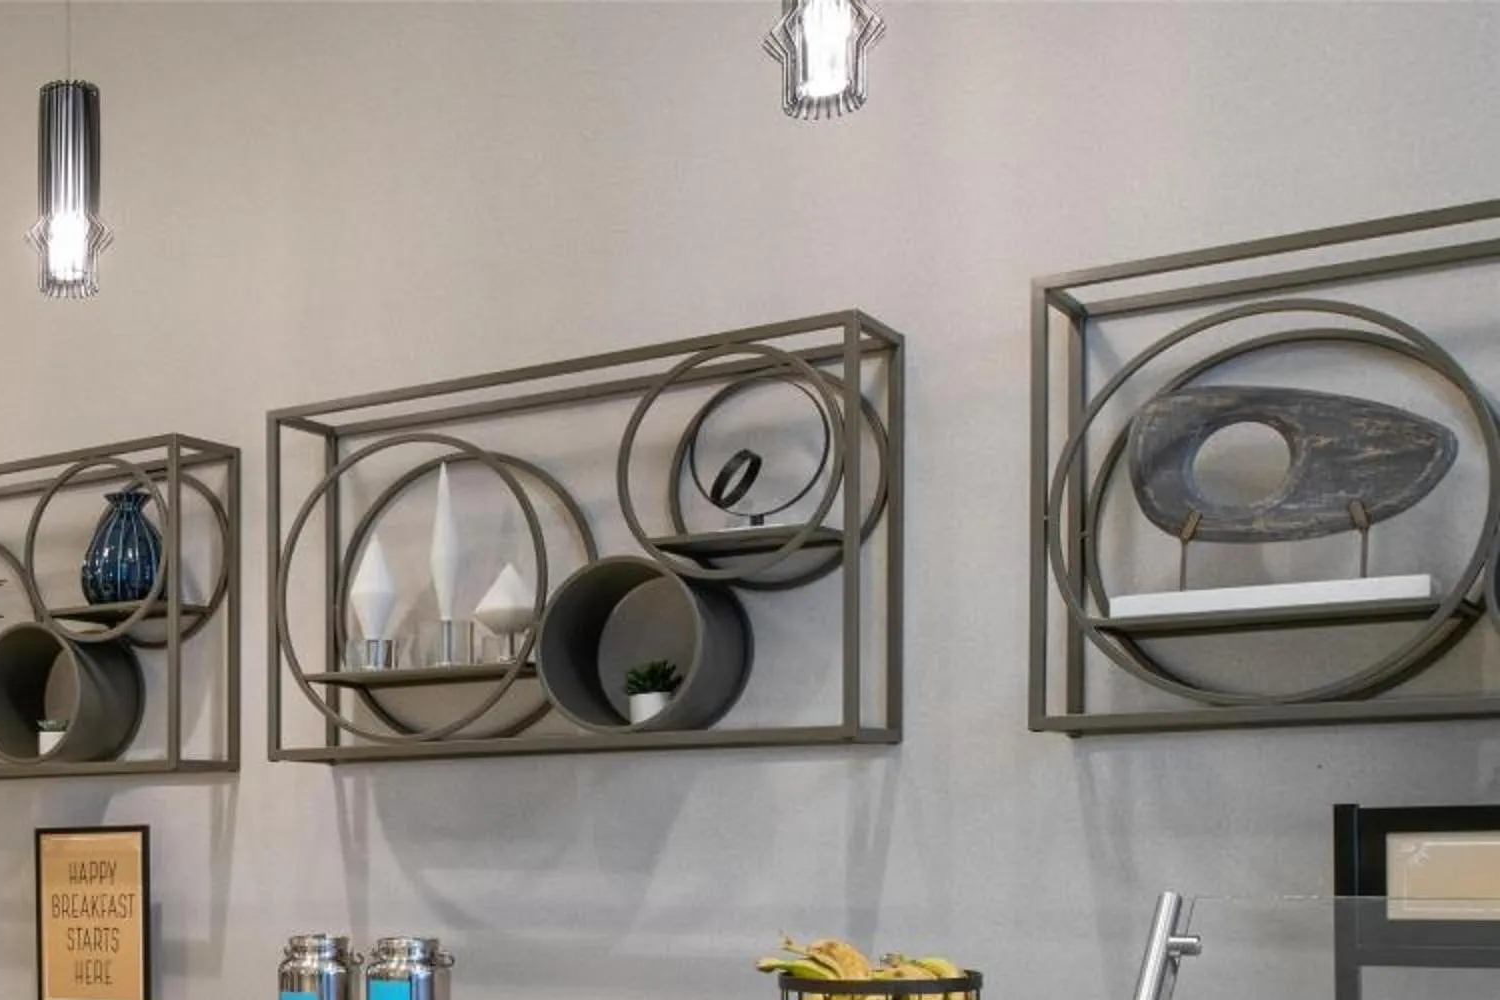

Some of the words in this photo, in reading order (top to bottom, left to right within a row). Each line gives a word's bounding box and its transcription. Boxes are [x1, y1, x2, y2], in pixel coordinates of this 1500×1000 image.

[68, 860, 117, 886] HAPPY
[51, 892, 137, 920] BREAKFAST
[66, 927, 120, 953] STARTS
[74, 959, 113, 985] HERE
